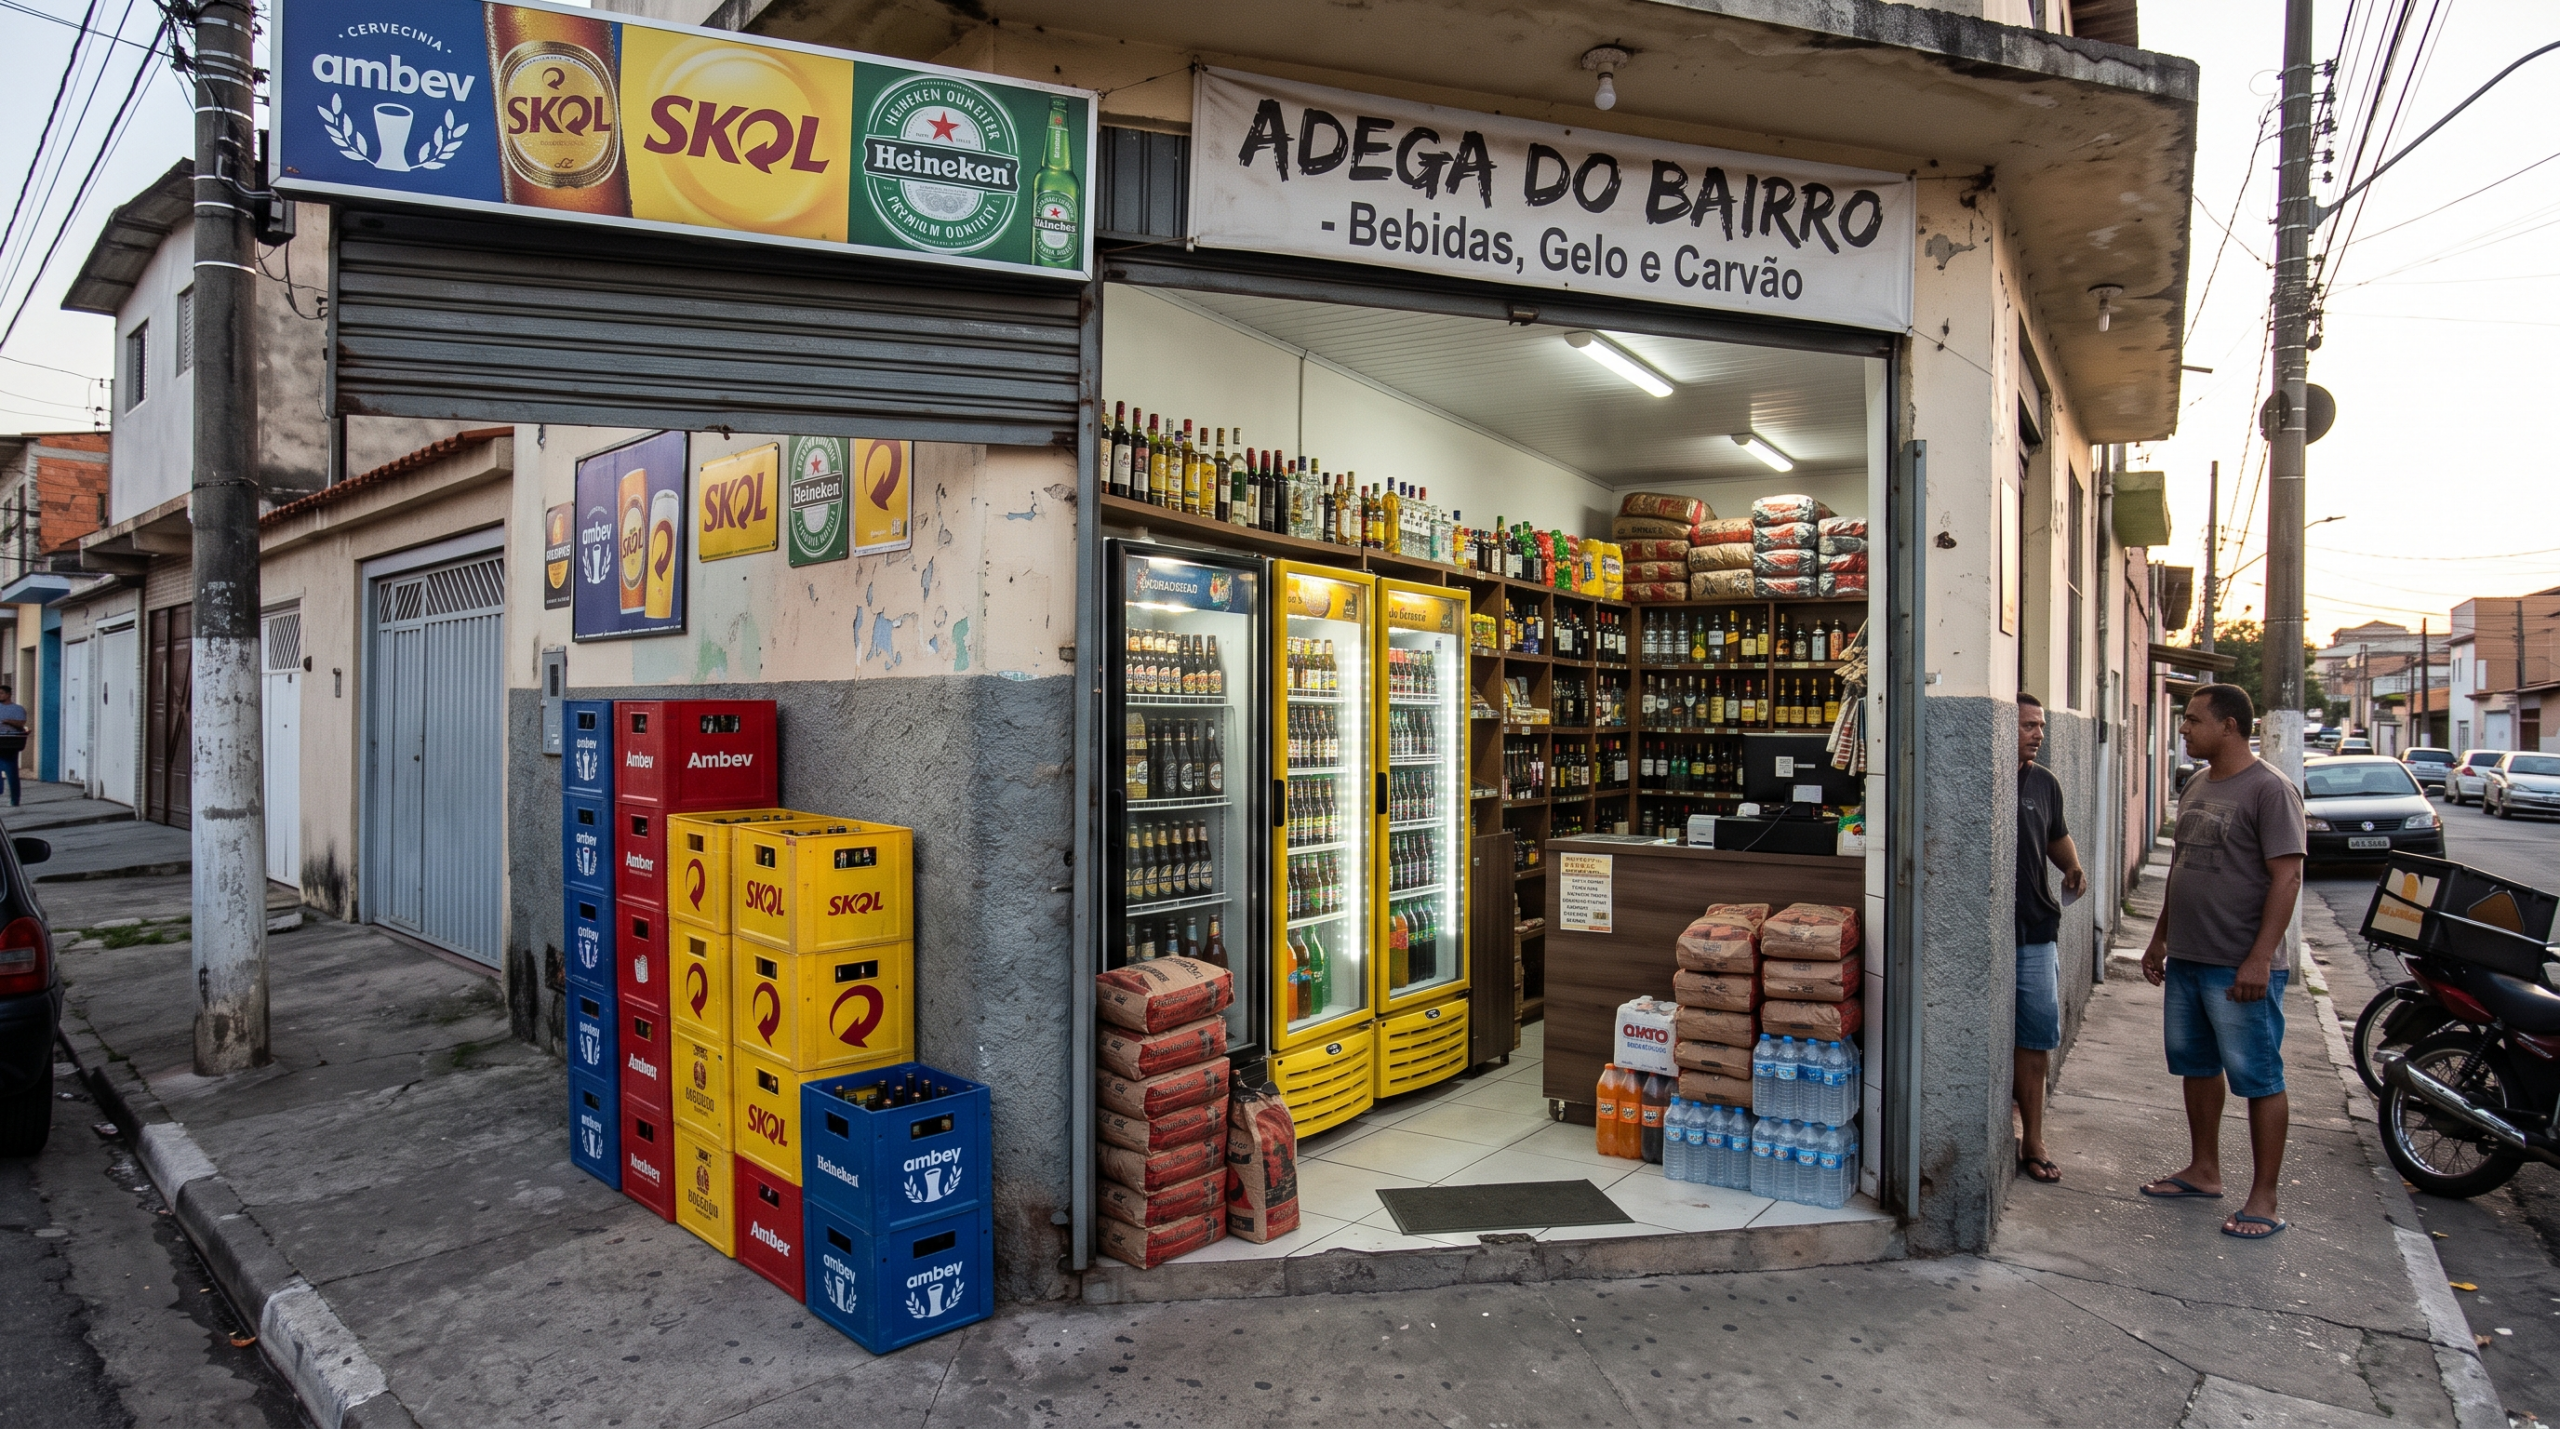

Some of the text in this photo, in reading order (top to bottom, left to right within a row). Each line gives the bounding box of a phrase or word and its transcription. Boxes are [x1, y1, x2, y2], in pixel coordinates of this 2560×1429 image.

[347, 22, 442, 51] CERVECINIA
[312, 53, 475, 102] ambev
[885, 88, 941, 127] HEINEKEN
[643, 95, 831, 174] SKOL
[874, 143, 1010, 186] Heineken
[1238, 99, 1884, 255] ADEGA DO BAIRRO
[1349, 201, 1525, 275] Bebidas,
[1539, 226, 1628, 281] Gelo
[1641, 251, 1661, 283] e
[1674, 244, 1804, 301] Carvão
[704, 471, 768, 533] SKOL
[687, 751, 754, 769] Ambev
[745, 879, 785, 918] SKOL
[827, 891, 884, 916] SKOL
[747, 1103, 788, 1148] SKOL
